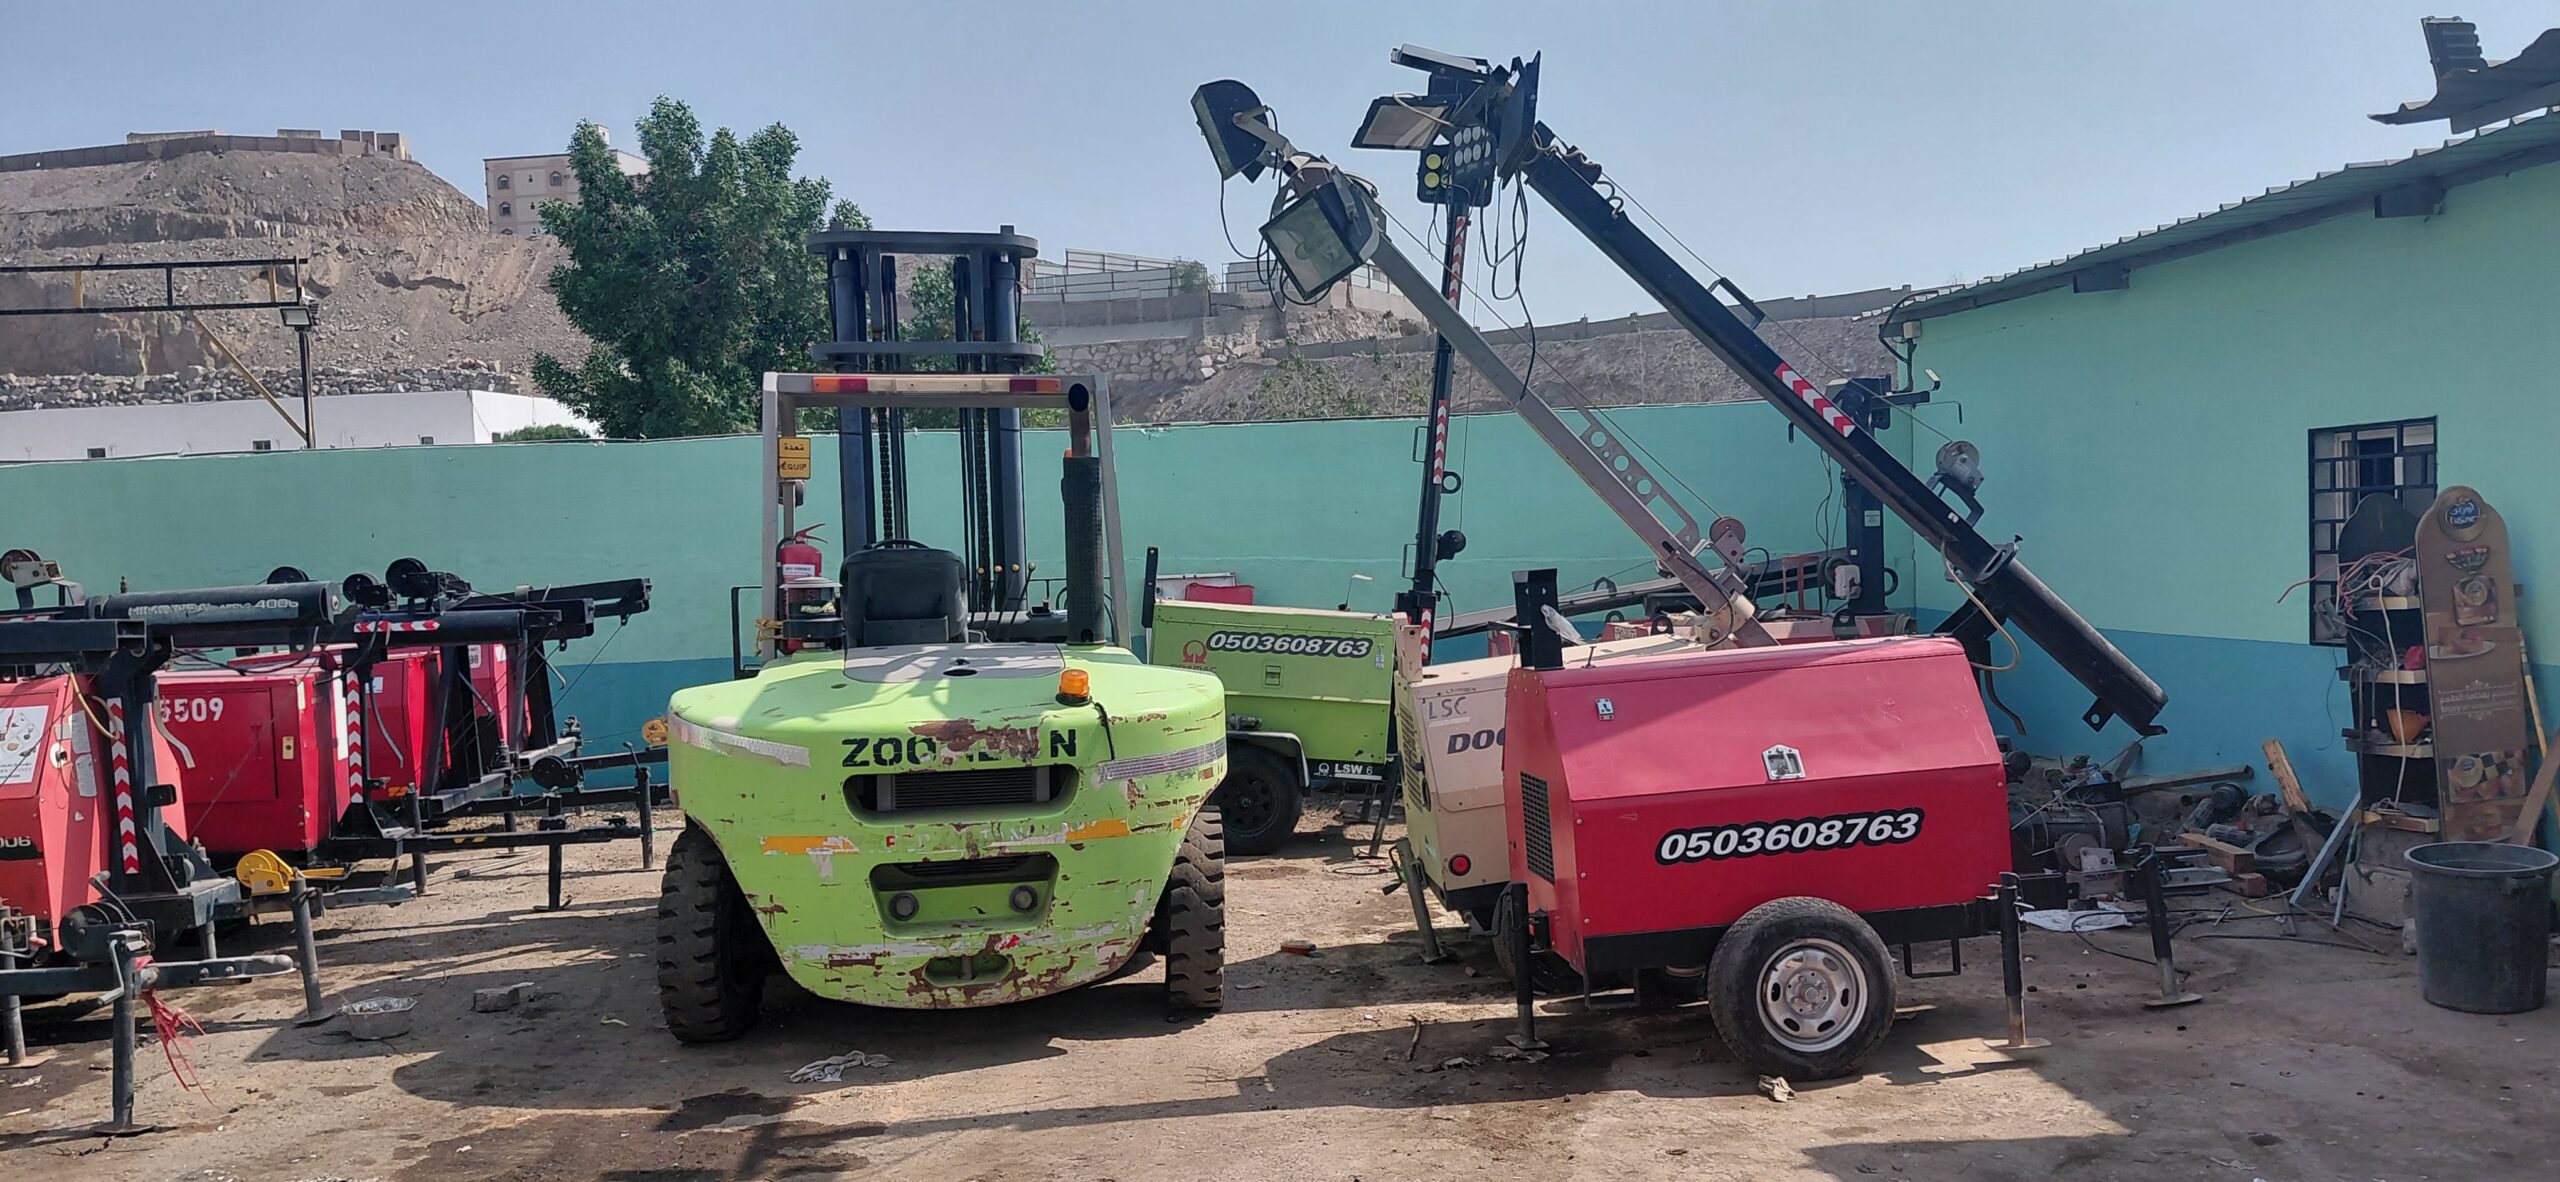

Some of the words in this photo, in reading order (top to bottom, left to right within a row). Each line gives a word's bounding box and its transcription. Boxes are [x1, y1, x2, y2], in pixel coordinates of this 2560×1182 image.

[1209, 632, 1370, 657] 0503608763
[1334, 763, 1363, 775] LSW
[1366, 765, 1374, 776] 6
[1660, 812, 1920, 861] 0503608763
